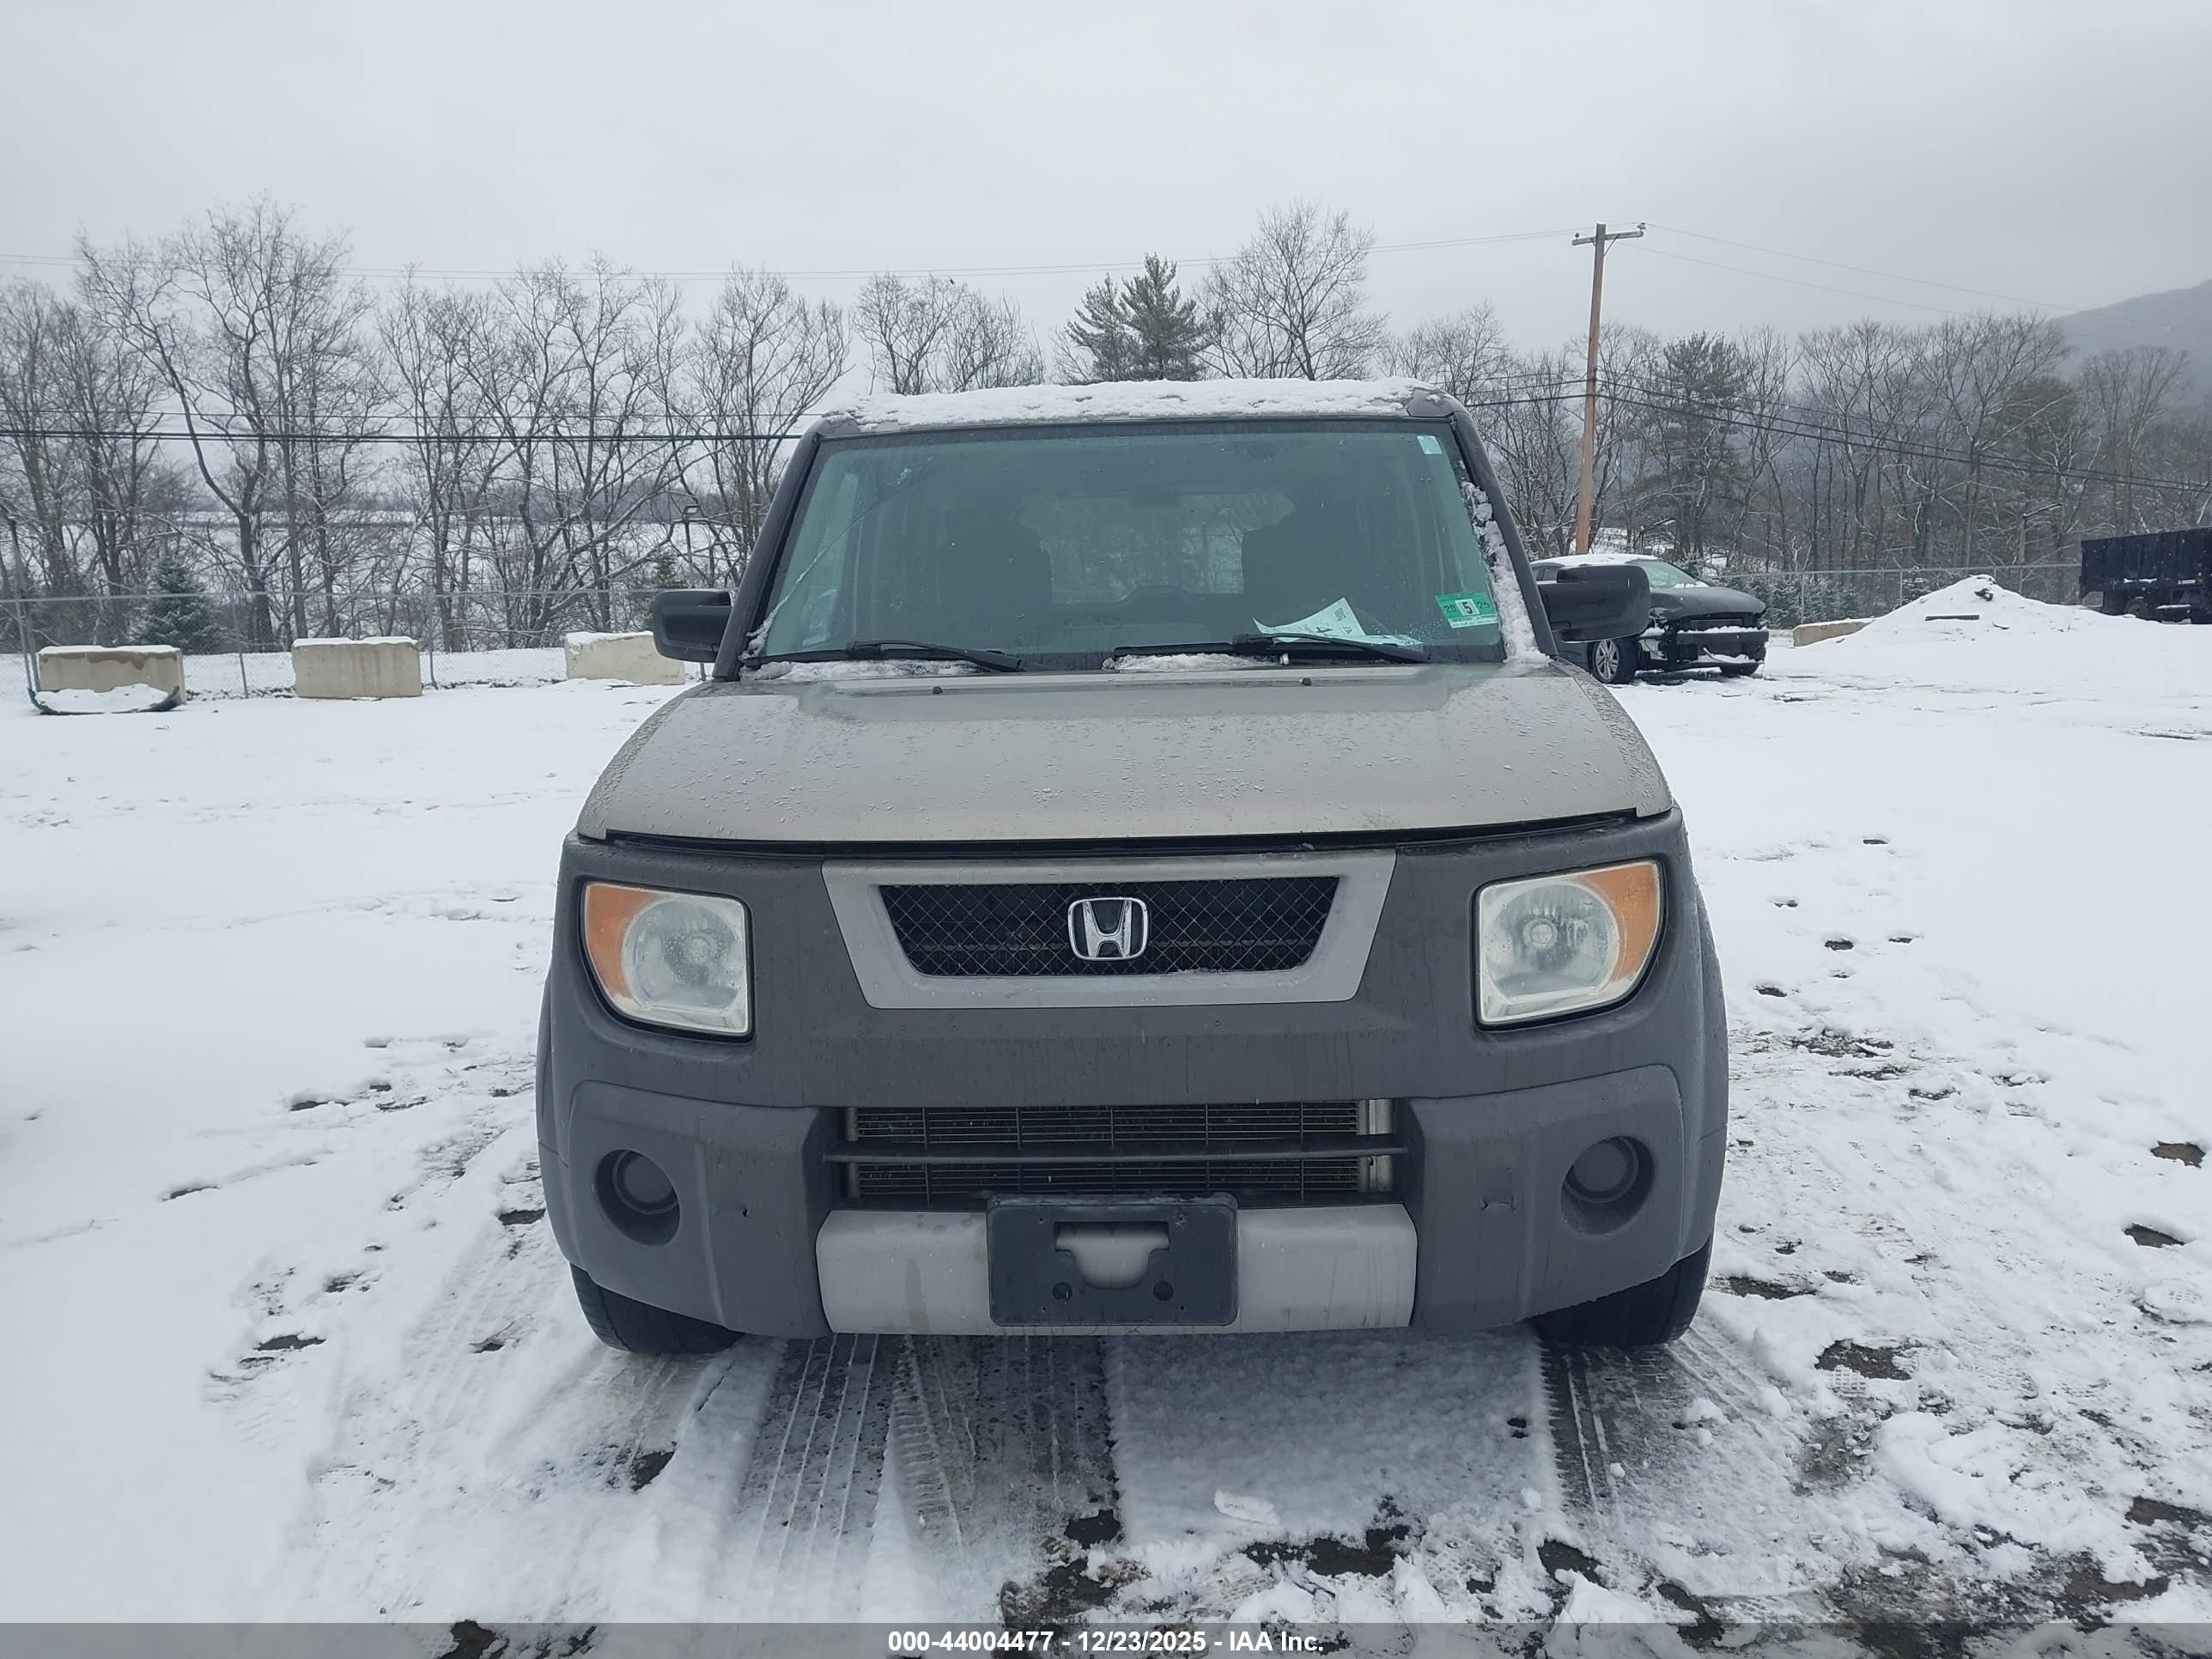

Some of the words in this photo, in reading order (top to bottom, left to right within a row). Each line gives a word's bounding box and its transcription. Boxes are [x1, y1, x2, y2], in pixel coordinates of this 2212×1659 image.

[1443, 604, 1457, 613] 20
[1462, 601, 1474, 615] 5
[1476, 600, 1491, 610] 25
